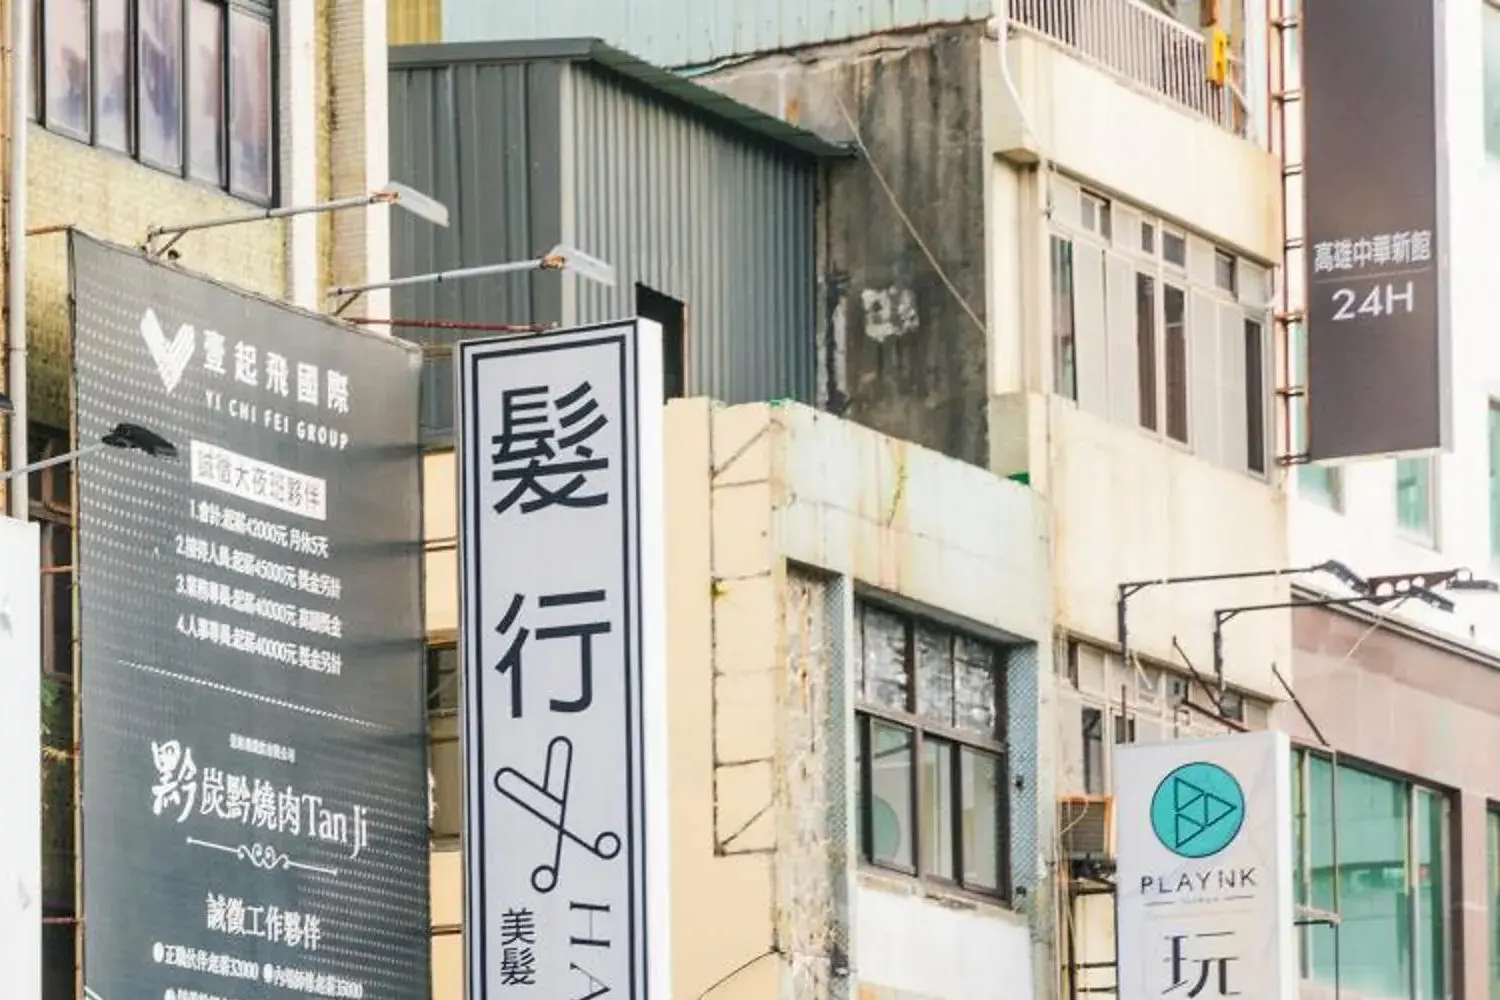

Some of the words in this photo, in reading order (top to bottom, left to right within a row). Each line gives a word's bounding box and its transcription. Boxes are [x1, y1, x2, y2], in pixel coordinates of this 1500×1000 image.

[1313, 230, 1432, 273] 高雄中華新館
[1331, 281, 1414, 321] 24H
[229, 399, 257, 423] CHI
[264, 408, 289, 433] FEI
[297, 420, 349, 450] GROUP
[492, 381, 611, 718] 髮行
[501, 907, 537, 986] 美髮
